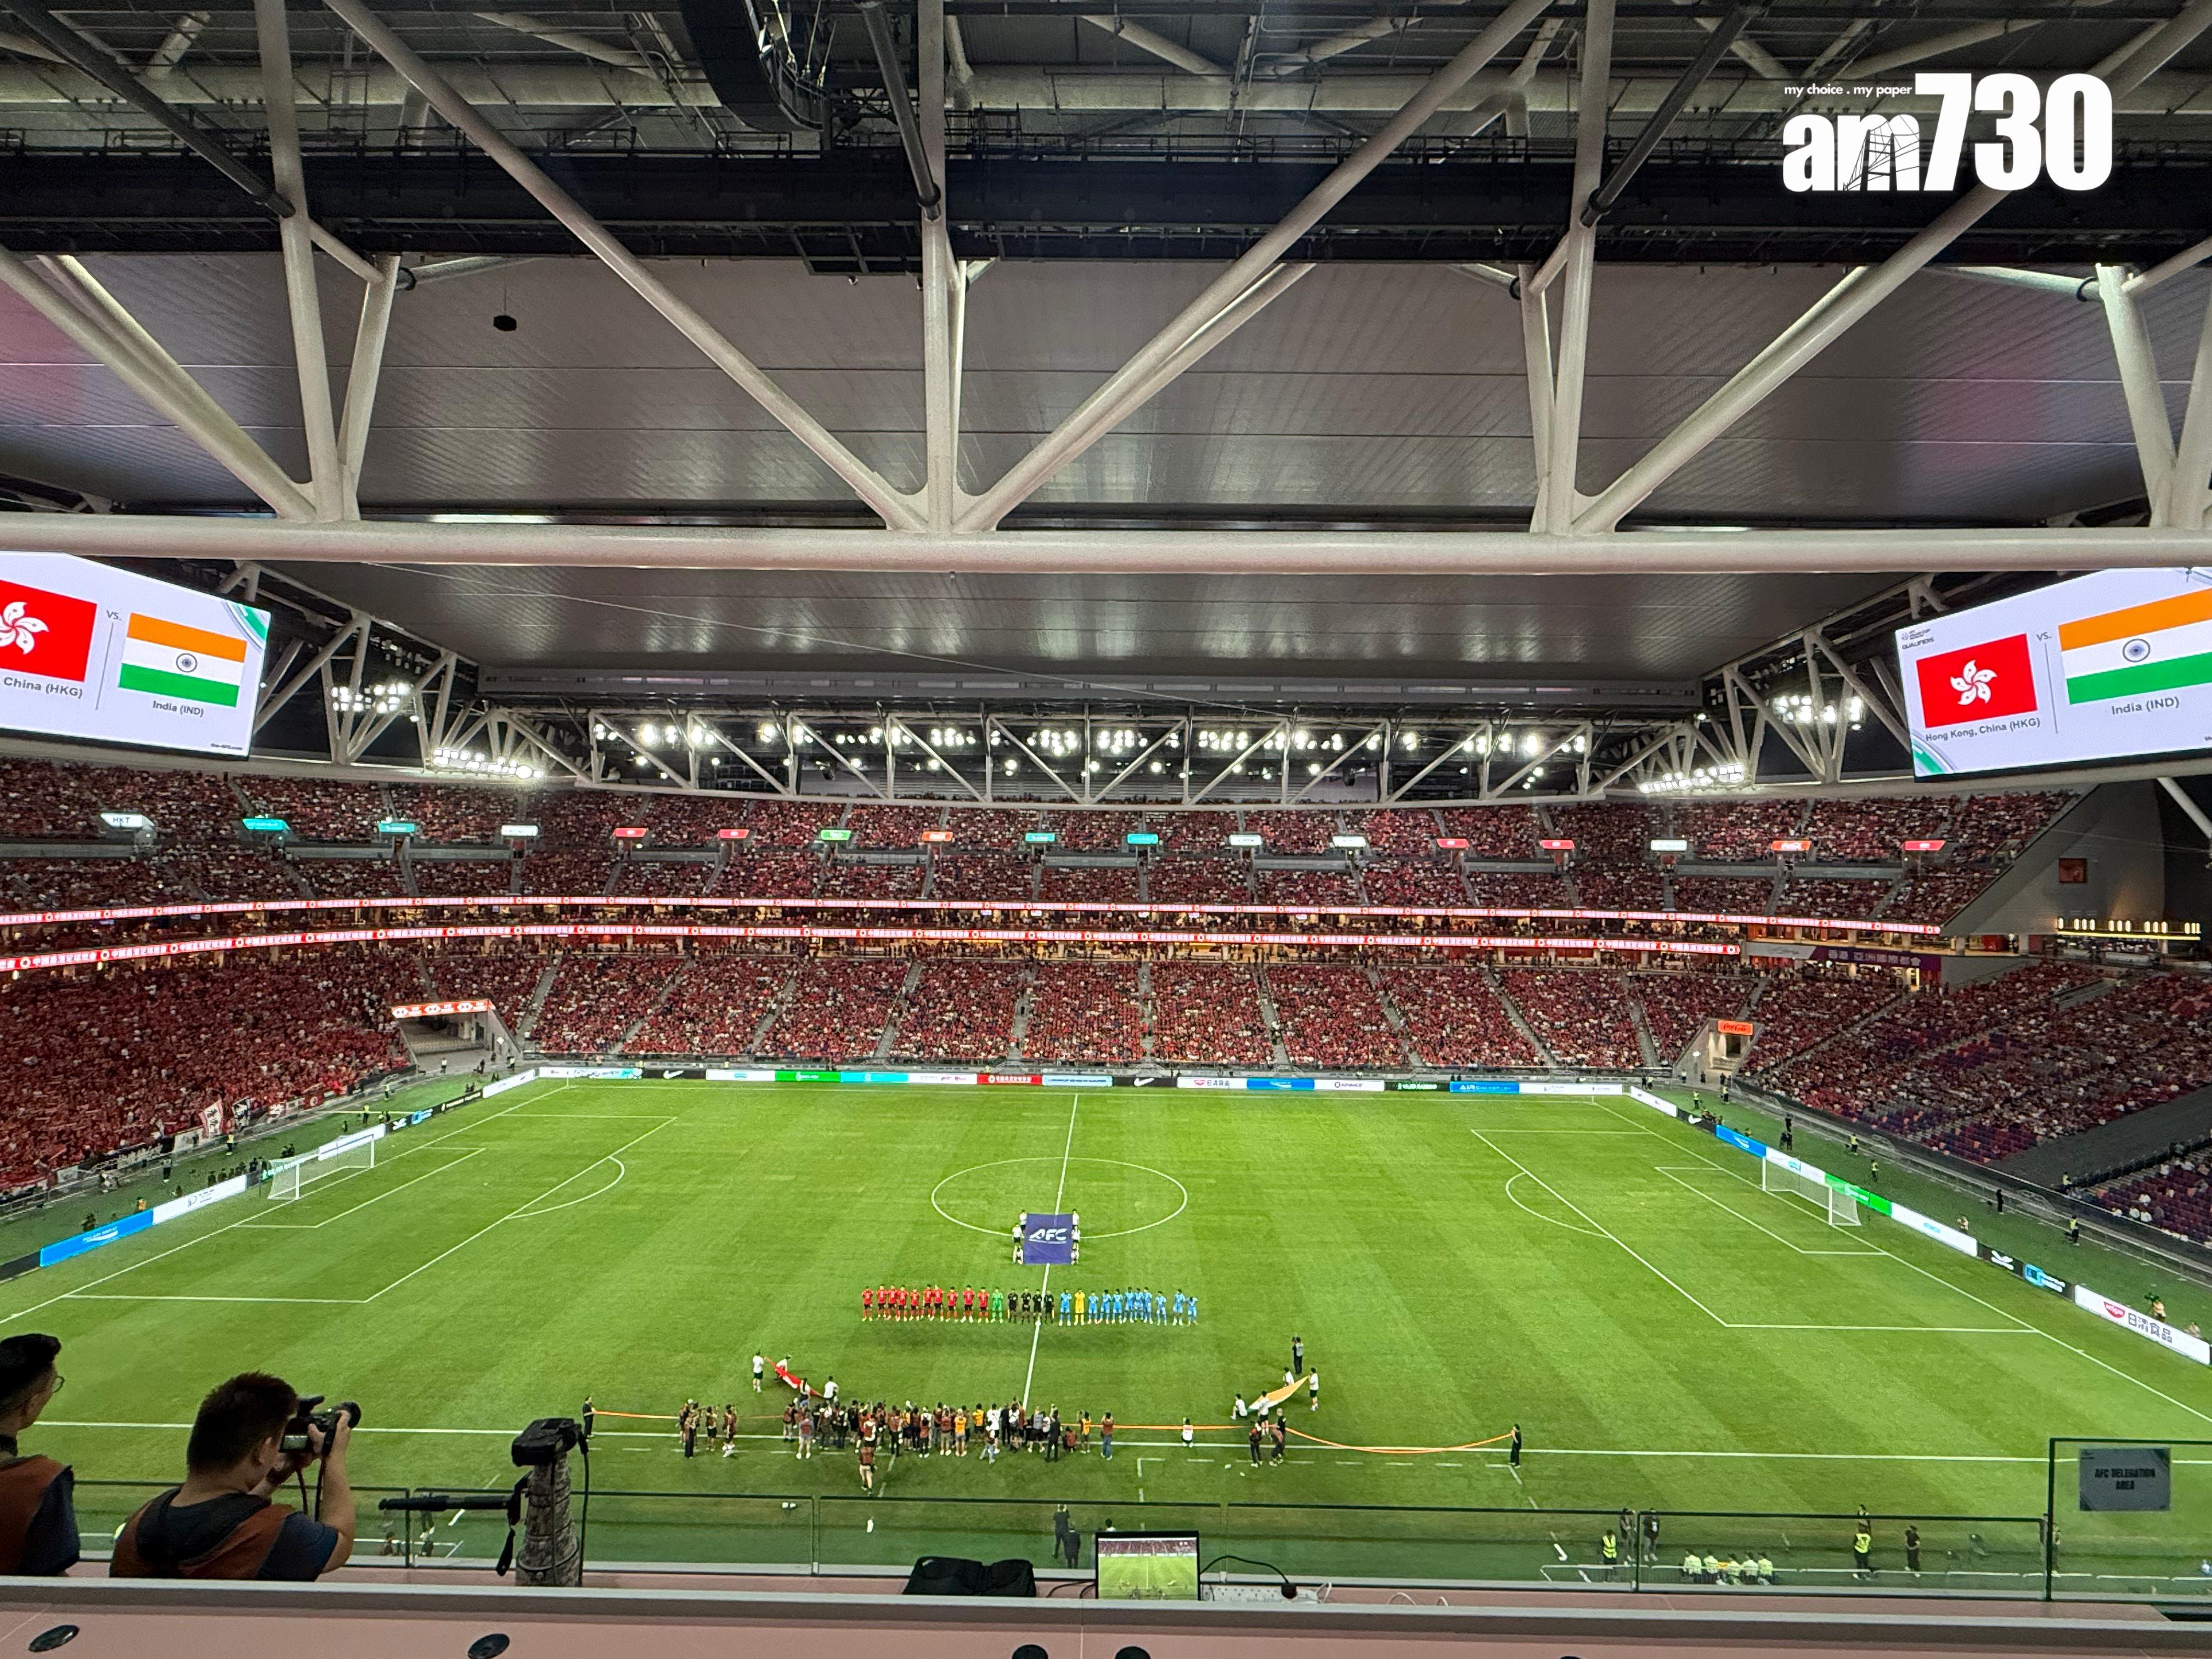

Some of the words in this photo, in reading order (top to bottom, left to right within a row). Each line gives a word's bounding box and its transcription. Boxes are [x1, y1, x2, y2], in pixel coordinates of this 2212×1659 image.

[3, 676, 42, 691] China
[46, 684, 83, 698] (HKG)
[153, 701, 177, 712] India
[180, 704, 204, 717] (IND)
[2112, 702, 2142, 715] India
[2146, 696, 2180, 712] (IND)
[1926, 731, 1949, 742] Hong
[1979, 723, 2007, 734] China
[2010, 718, 2041, 731] (HKG)
[1029, 1228, 1067, 1241] AFC
[2128, 1312, 2172, 1344] 日清食品
